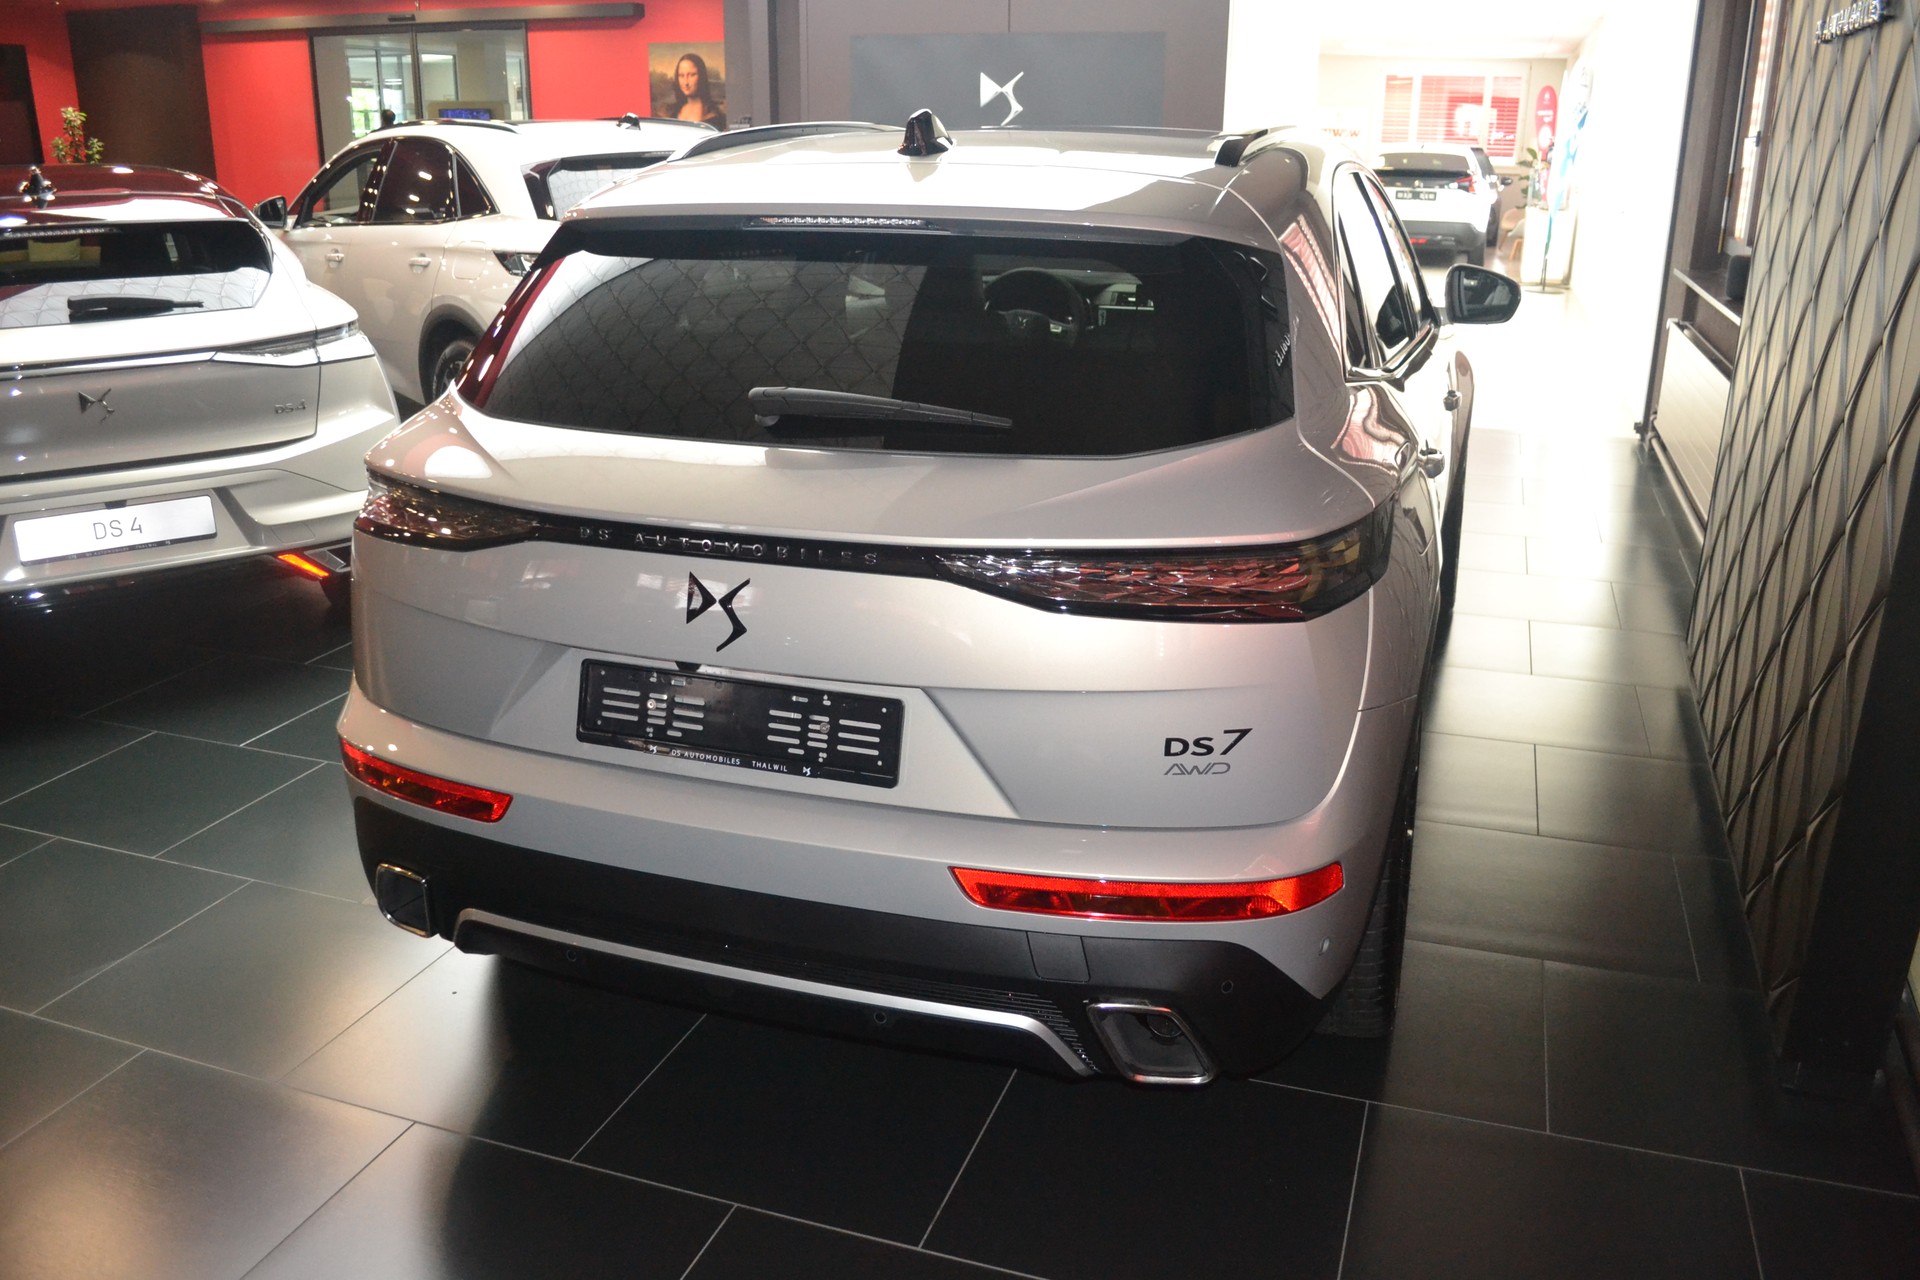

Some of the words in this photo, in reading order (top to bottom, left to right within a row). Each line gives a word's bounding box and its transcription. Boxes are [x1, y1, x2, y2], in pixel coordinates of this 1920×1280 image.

[93, 519, 123, 540] DS
[130, 516, 143, 534] 4
[580, 526, 610, 540] DS
[634, 532, 878, 565] AUTOMOBILES
[671, 749, 681, 757] DS
[684, 751, 741, 765] AUTOMOBILES
[752, 760, 788, 772] THALWIL
[1164, 762, 1231, 775] AWD
